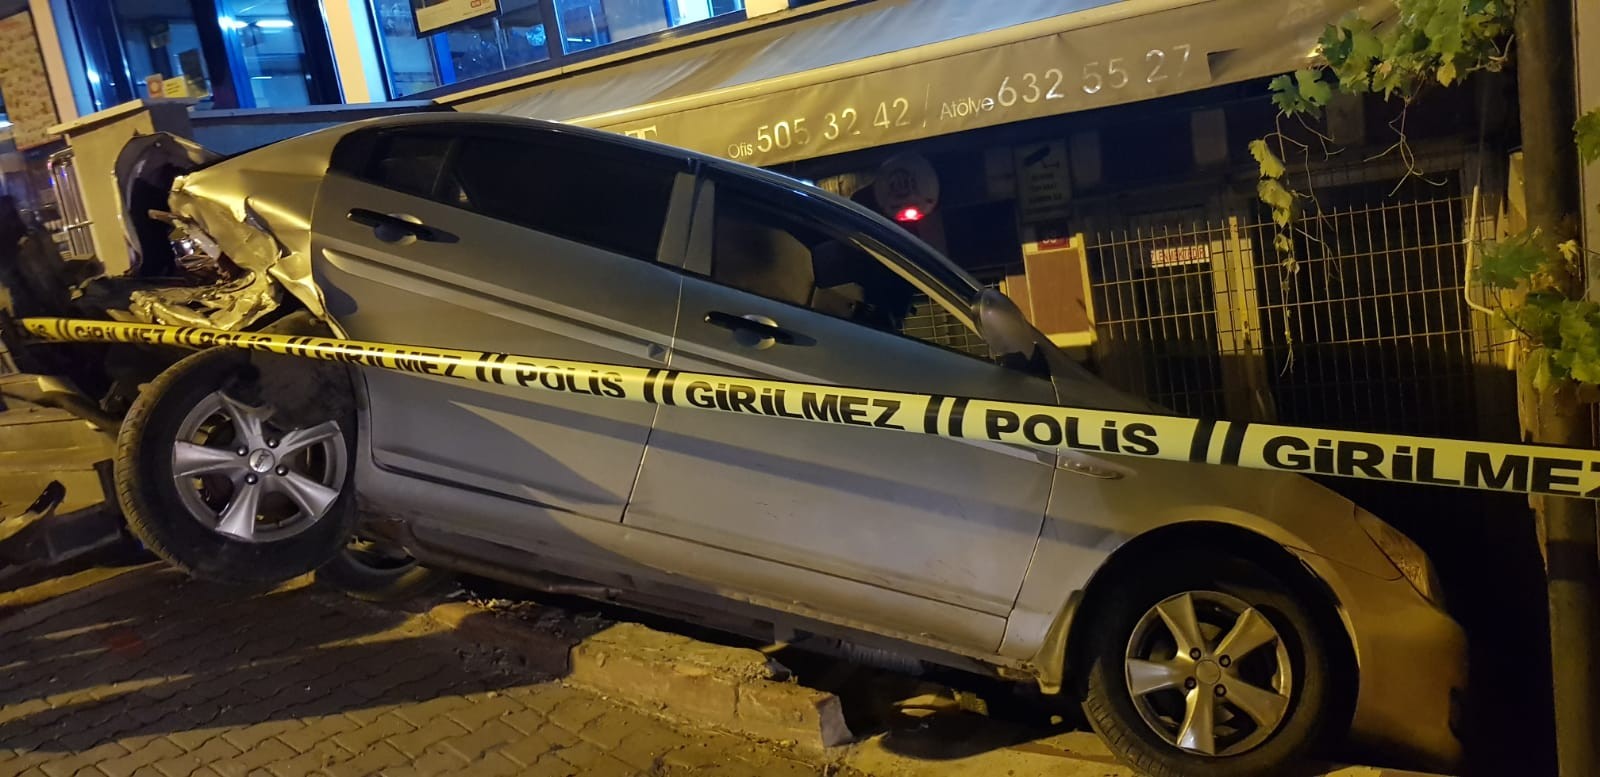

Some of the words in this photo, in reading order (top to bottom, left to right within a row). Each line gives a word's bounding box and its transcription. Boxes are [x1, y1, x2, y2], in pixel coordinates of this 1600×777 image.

[728, 142, 753, 159] Ofis
[757, 118, 811, 153] 505
[824, 107, 861, 141] 32
[873, 97, 910, 129] 42
[997, 68, 1065, 107] 632
[1081, 57, 1129, 95] 55
[1145, 44, 1191, 84] 27
[1262, 435, 1600, 498] GiRiLME
